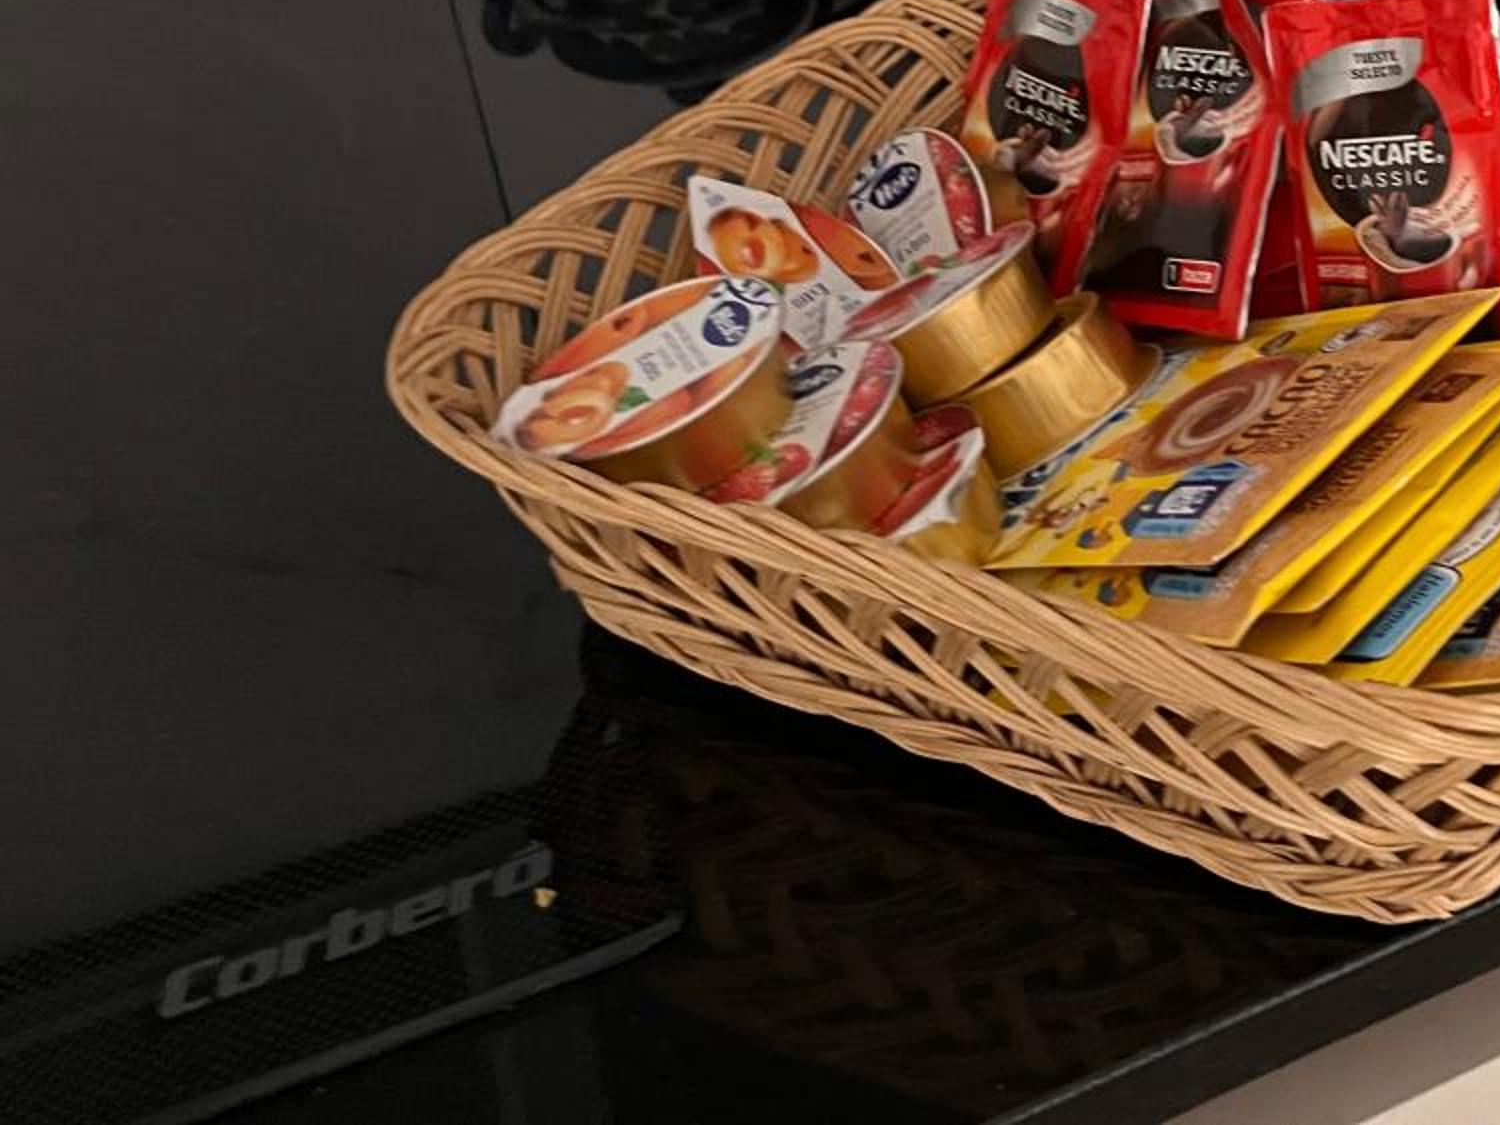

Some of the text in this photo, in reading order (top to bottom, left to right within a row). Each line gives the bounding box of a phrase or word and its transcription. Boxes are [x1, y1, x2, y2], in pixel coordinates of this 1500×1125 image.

[1353, 49, 1400, 65] TUESTE
[1350, 64, 1403, 80] SELECTO
[1155, 75, 1240, 94] CLASSIC
[1331, 169, 1429, 191] CLASSIC
